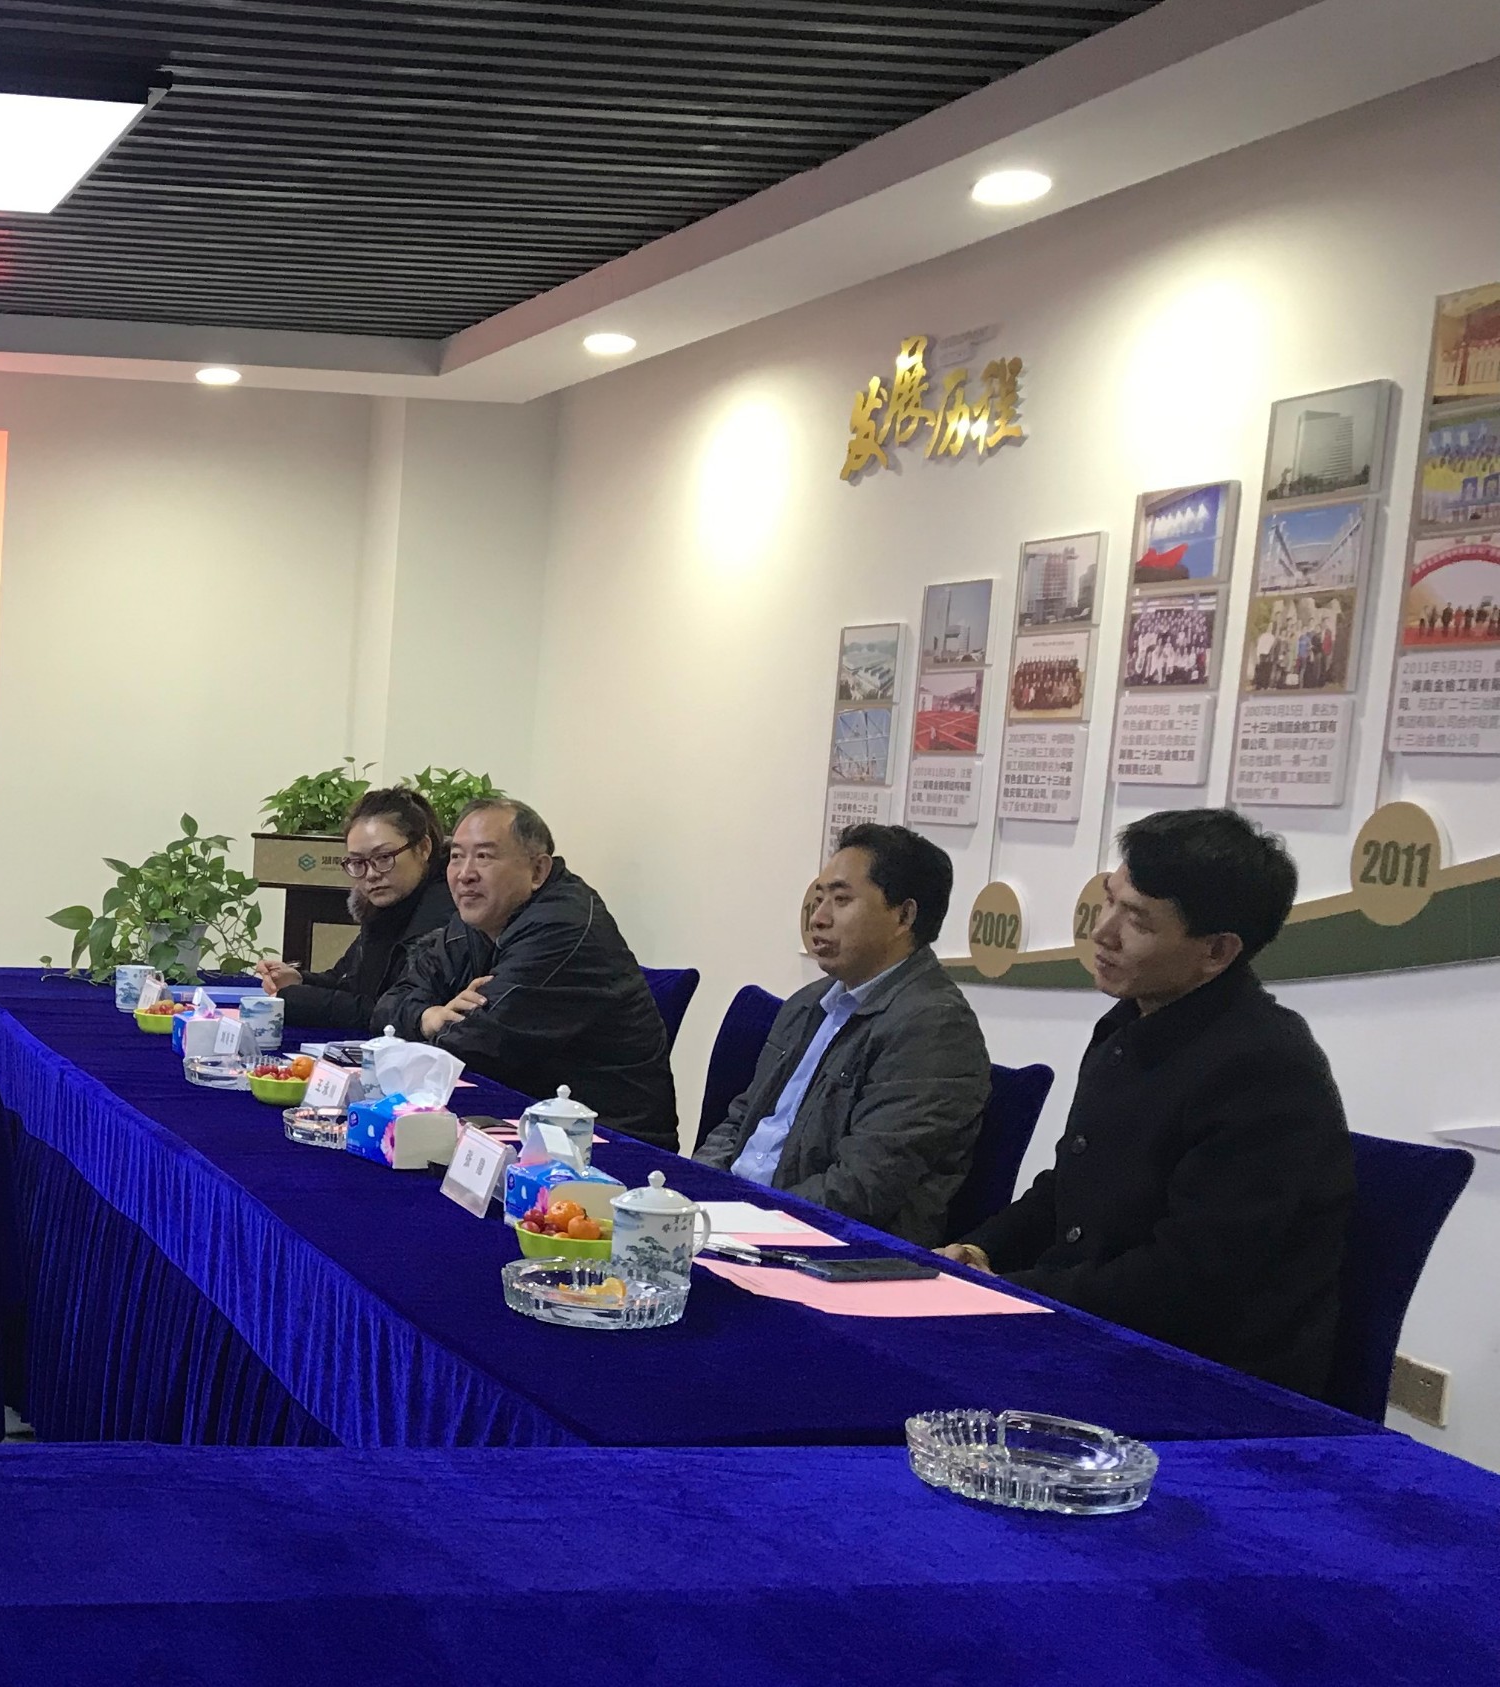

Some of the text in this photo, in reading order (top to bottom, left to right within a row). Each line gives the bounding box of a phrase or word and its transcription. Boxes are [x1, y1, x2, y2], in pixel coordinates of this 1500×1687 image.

[840, 335, 1023, 481] 发展历程
[1360, 839, 1432, 888] 2011
[972, 909, 1020, 950] 2002
